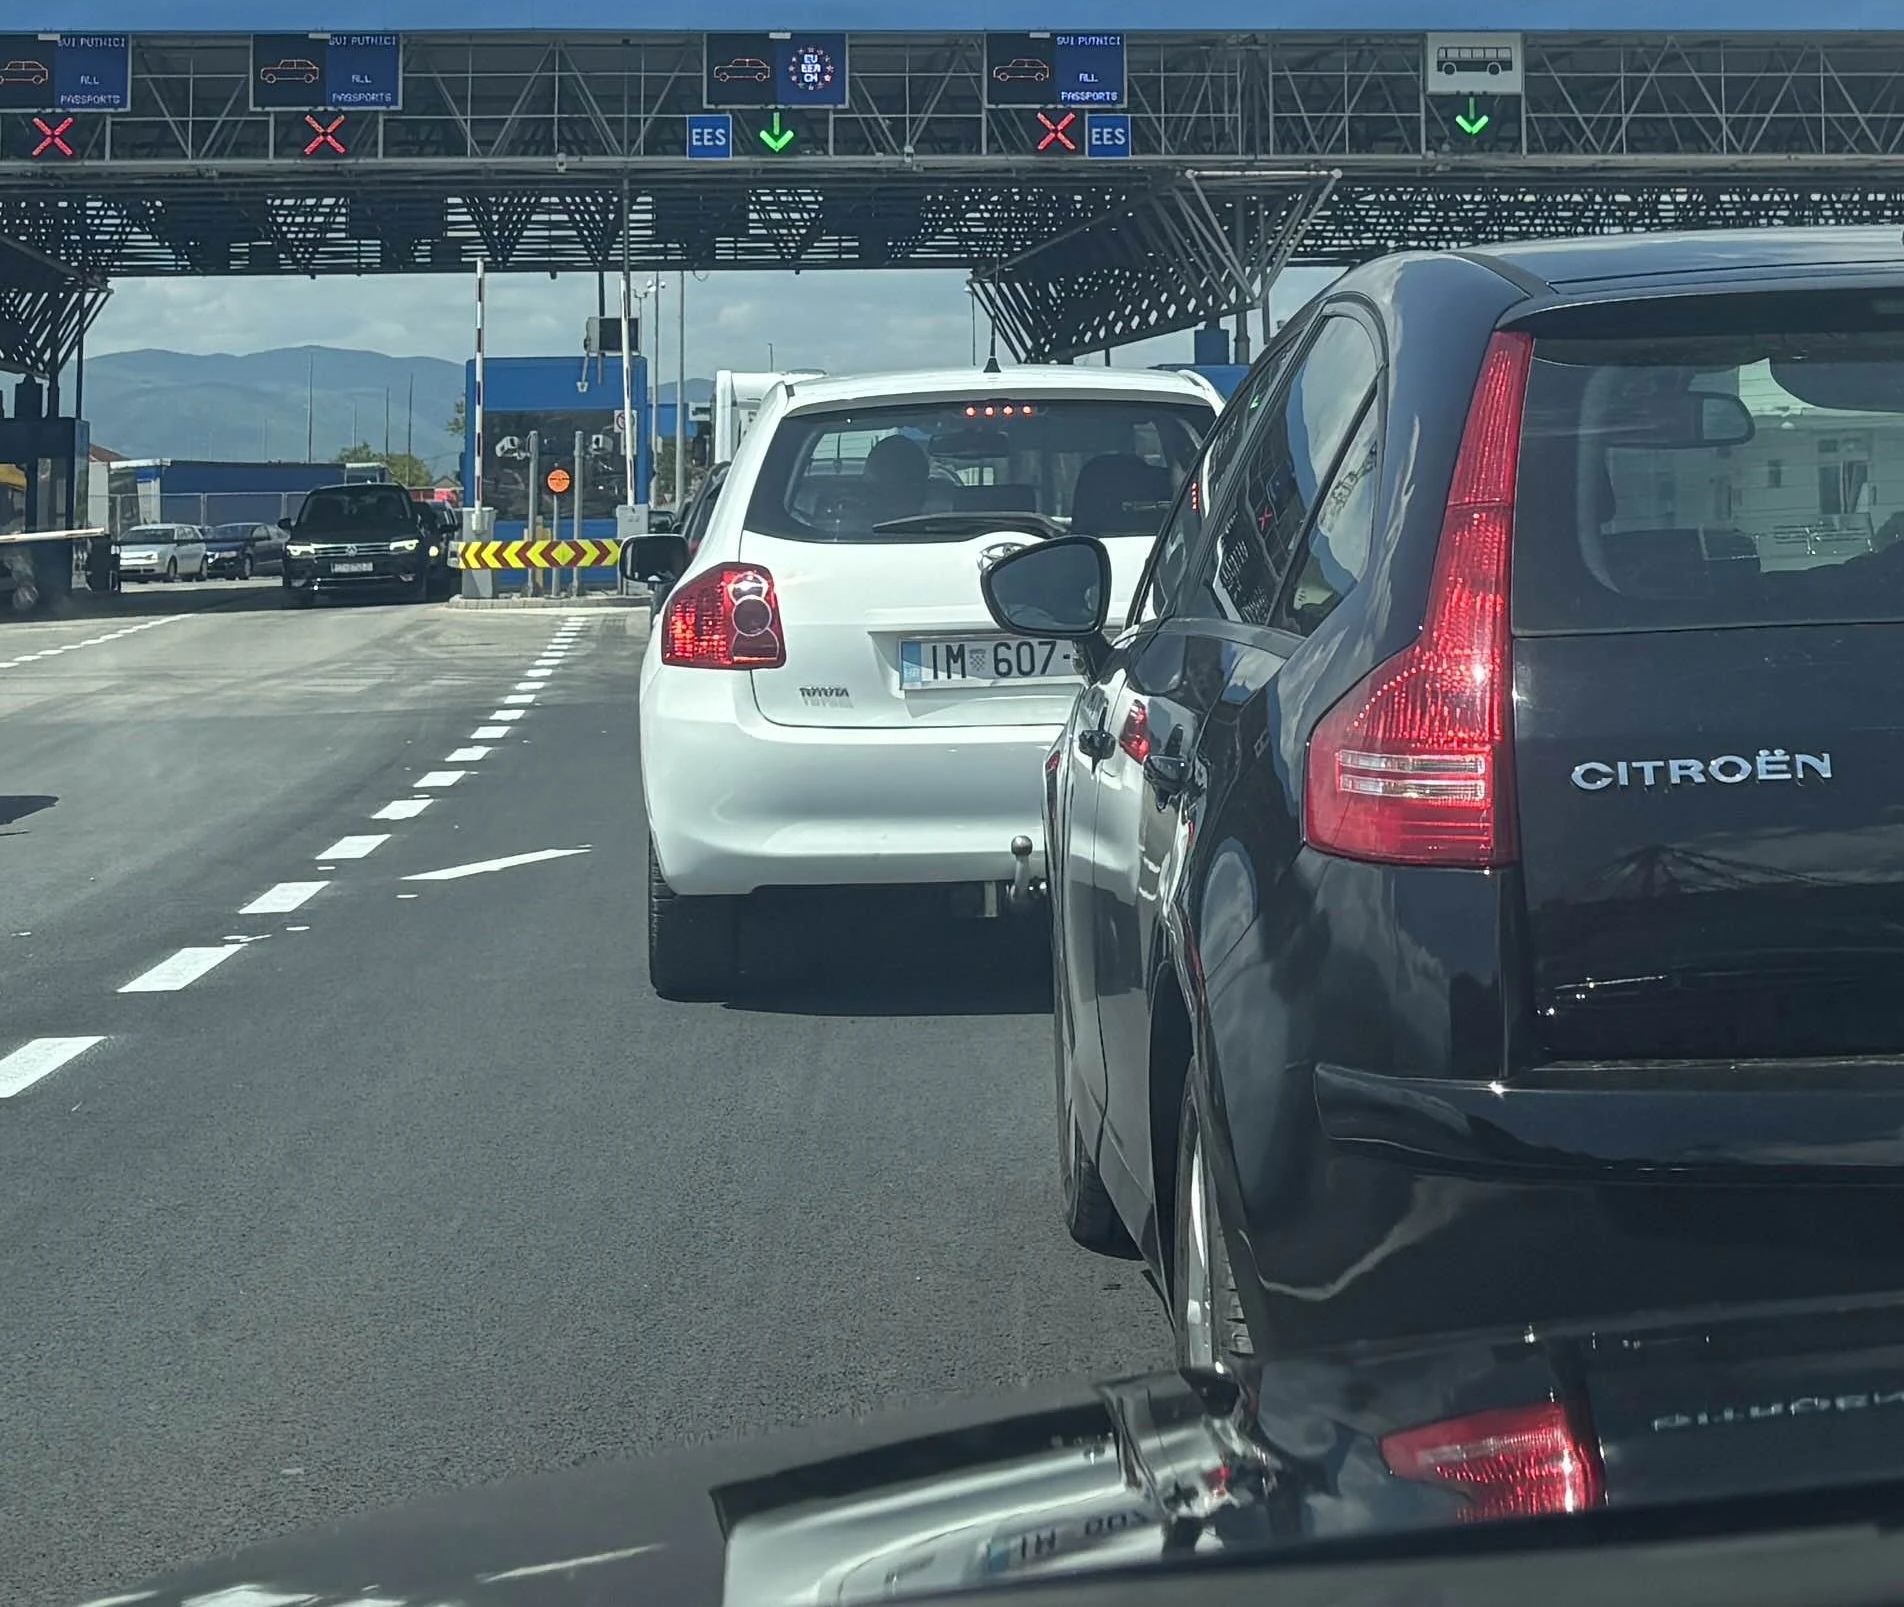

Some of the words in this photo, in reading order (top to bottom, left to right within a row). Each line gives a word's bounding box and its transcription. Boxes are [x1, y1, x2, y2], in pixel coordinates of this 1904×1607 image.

[1078, 36, 1121, 46] PUTNICI
[804, 54, 818, 63] EU
[80, 75, 100, 85] ALL
[351, 74, 372, 83] ALL
[1079, 73, 1098, 83] ALL
[60, 94, 120, 105] PASSPORTS
[332, 92, 392, 103] PASSPORTS
[1061, 91, 1118, 102] PASSPORTS
[692, 128, 726, 146] EES
[1091, 128, 1126, 145] EES
[932, 644, 967, 680] IM
[993, 641, 1072, 677] 607-
[1571, 748, 1833, 790] CITROËN
